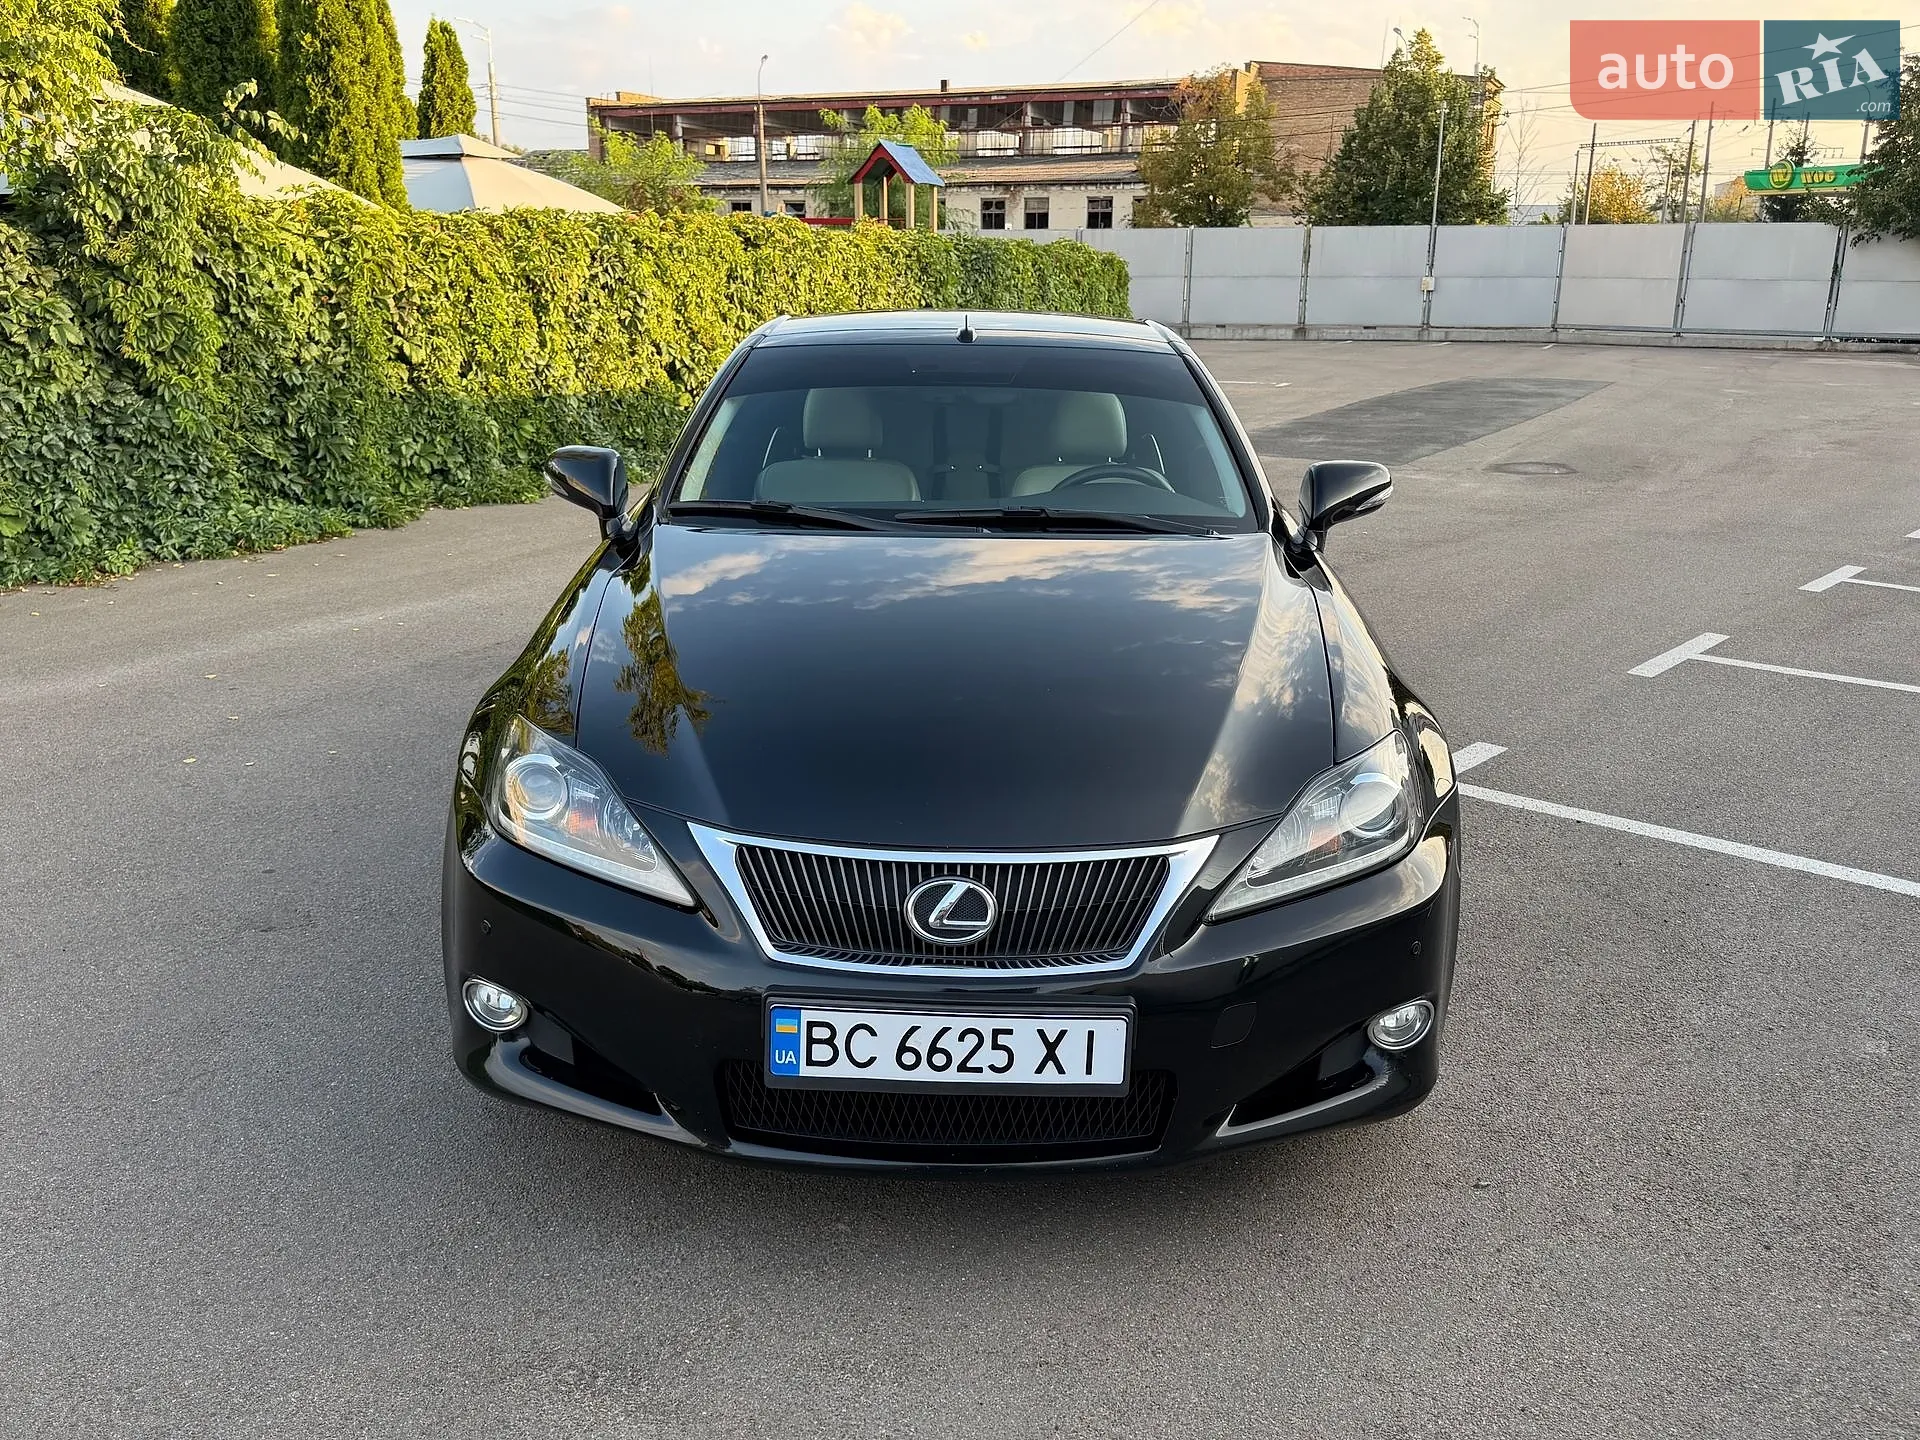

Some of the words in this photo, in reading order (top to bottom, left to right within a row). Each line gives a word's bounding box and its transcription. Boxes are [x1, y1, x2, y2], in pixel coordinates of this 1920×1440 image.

[775, 1049, 797, 1065] UA
[804, 1020, 878, 1069] BC
[895, 1025, 1015, 1074] 6625
